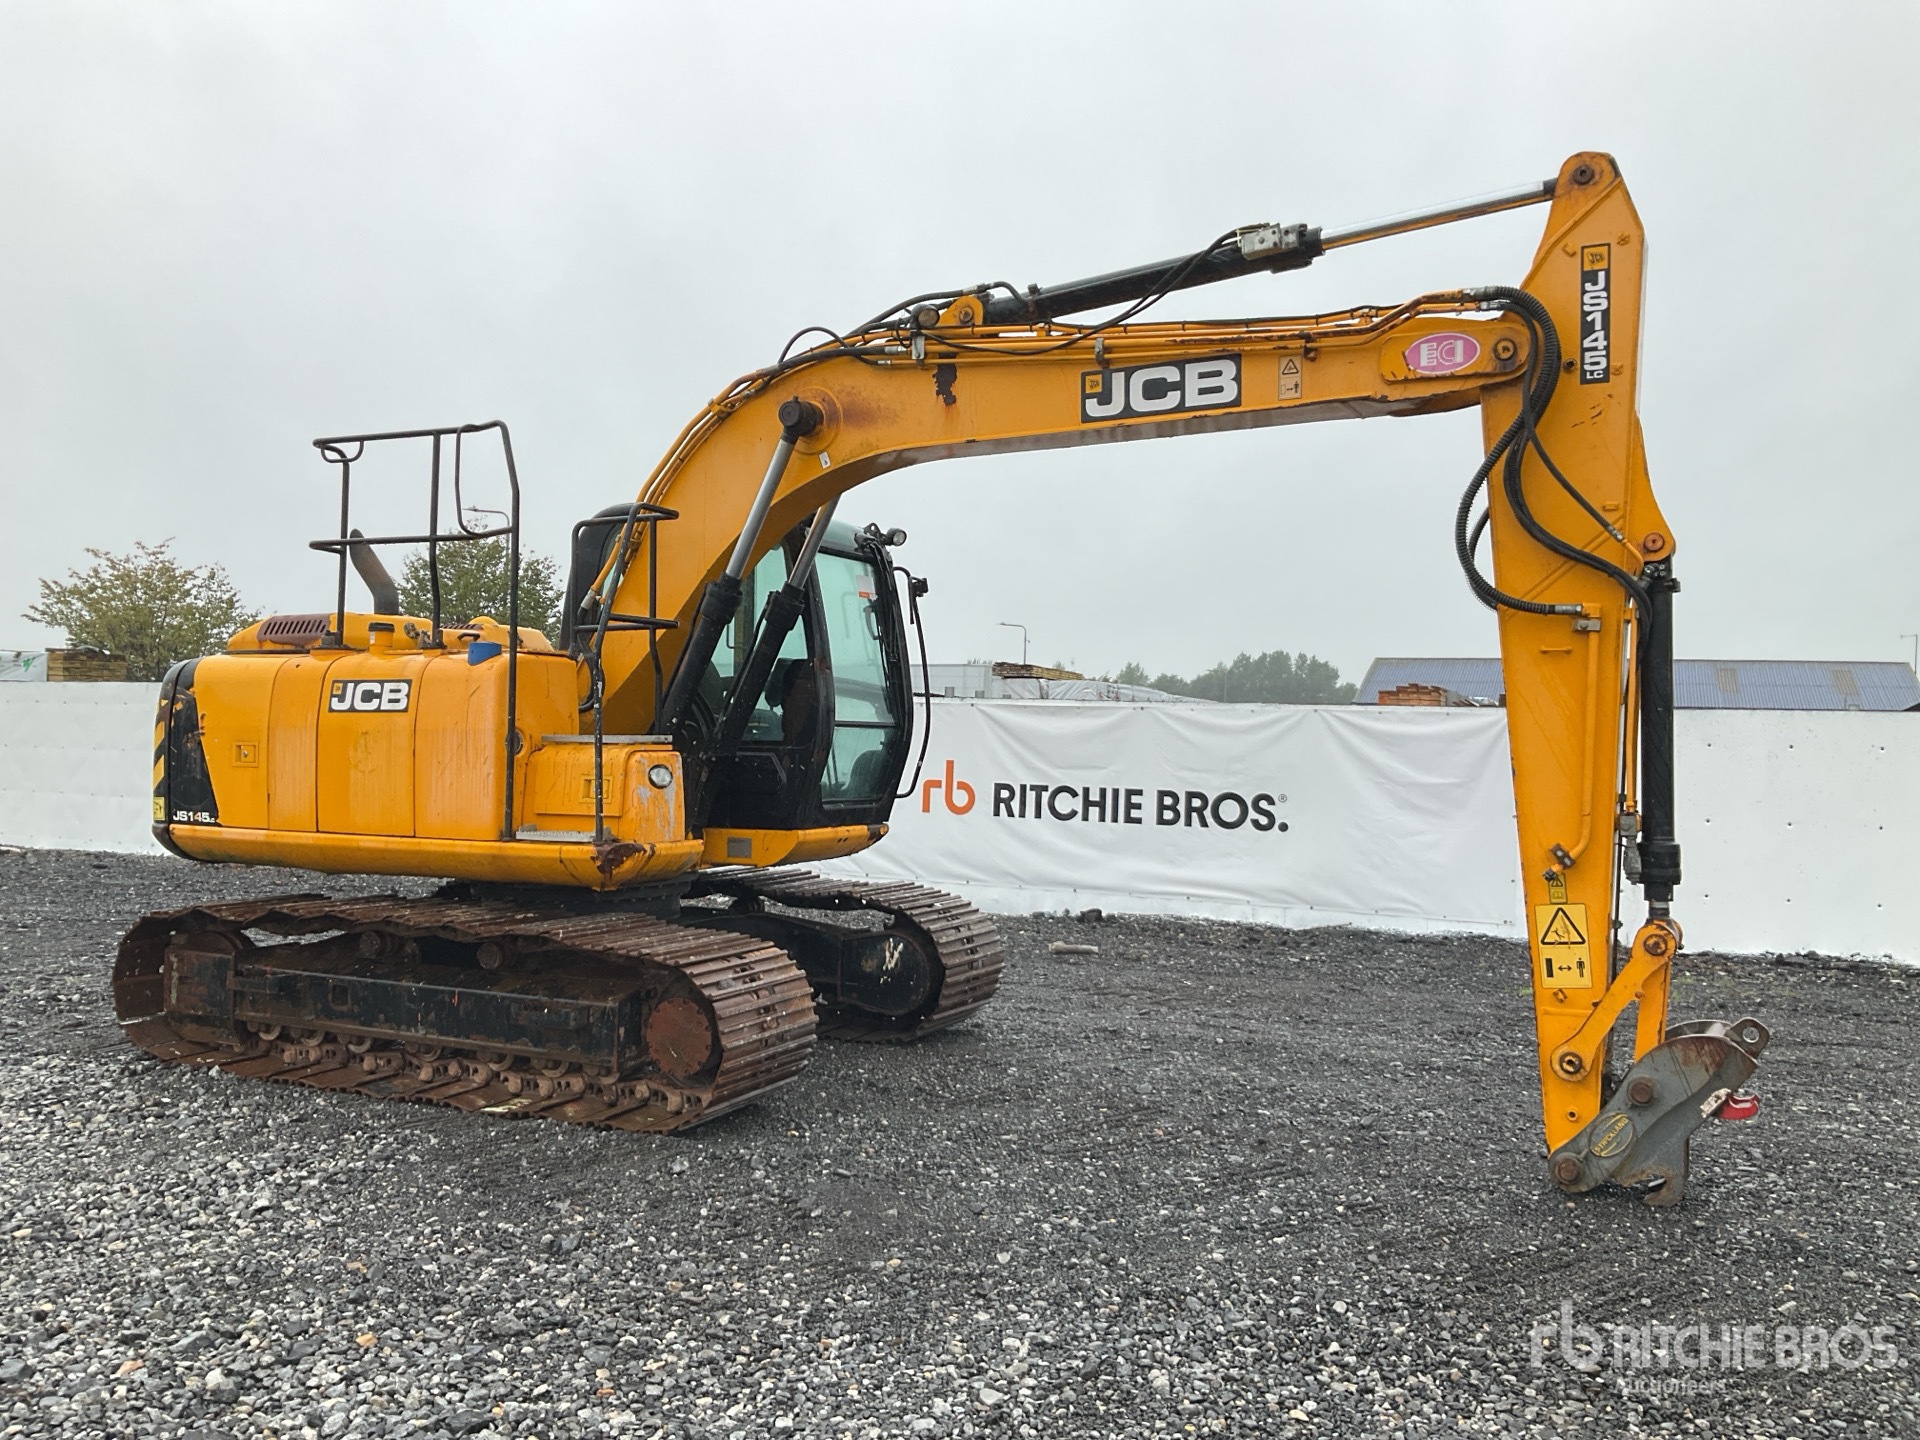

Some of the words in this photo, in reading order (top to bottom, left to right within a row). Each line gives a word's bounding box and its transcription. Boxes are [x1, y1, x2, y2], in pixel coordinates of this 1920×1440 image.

[1582, 270, 1609, 371] JS145
[1085, 359, 1239, 417] JCB
[331, 682, 409, 711] JCB
[173, 811, 210, 823] JS145
[922, 760, 976, 815] rb
[993, 782, 1143, 825] RITCHIE
